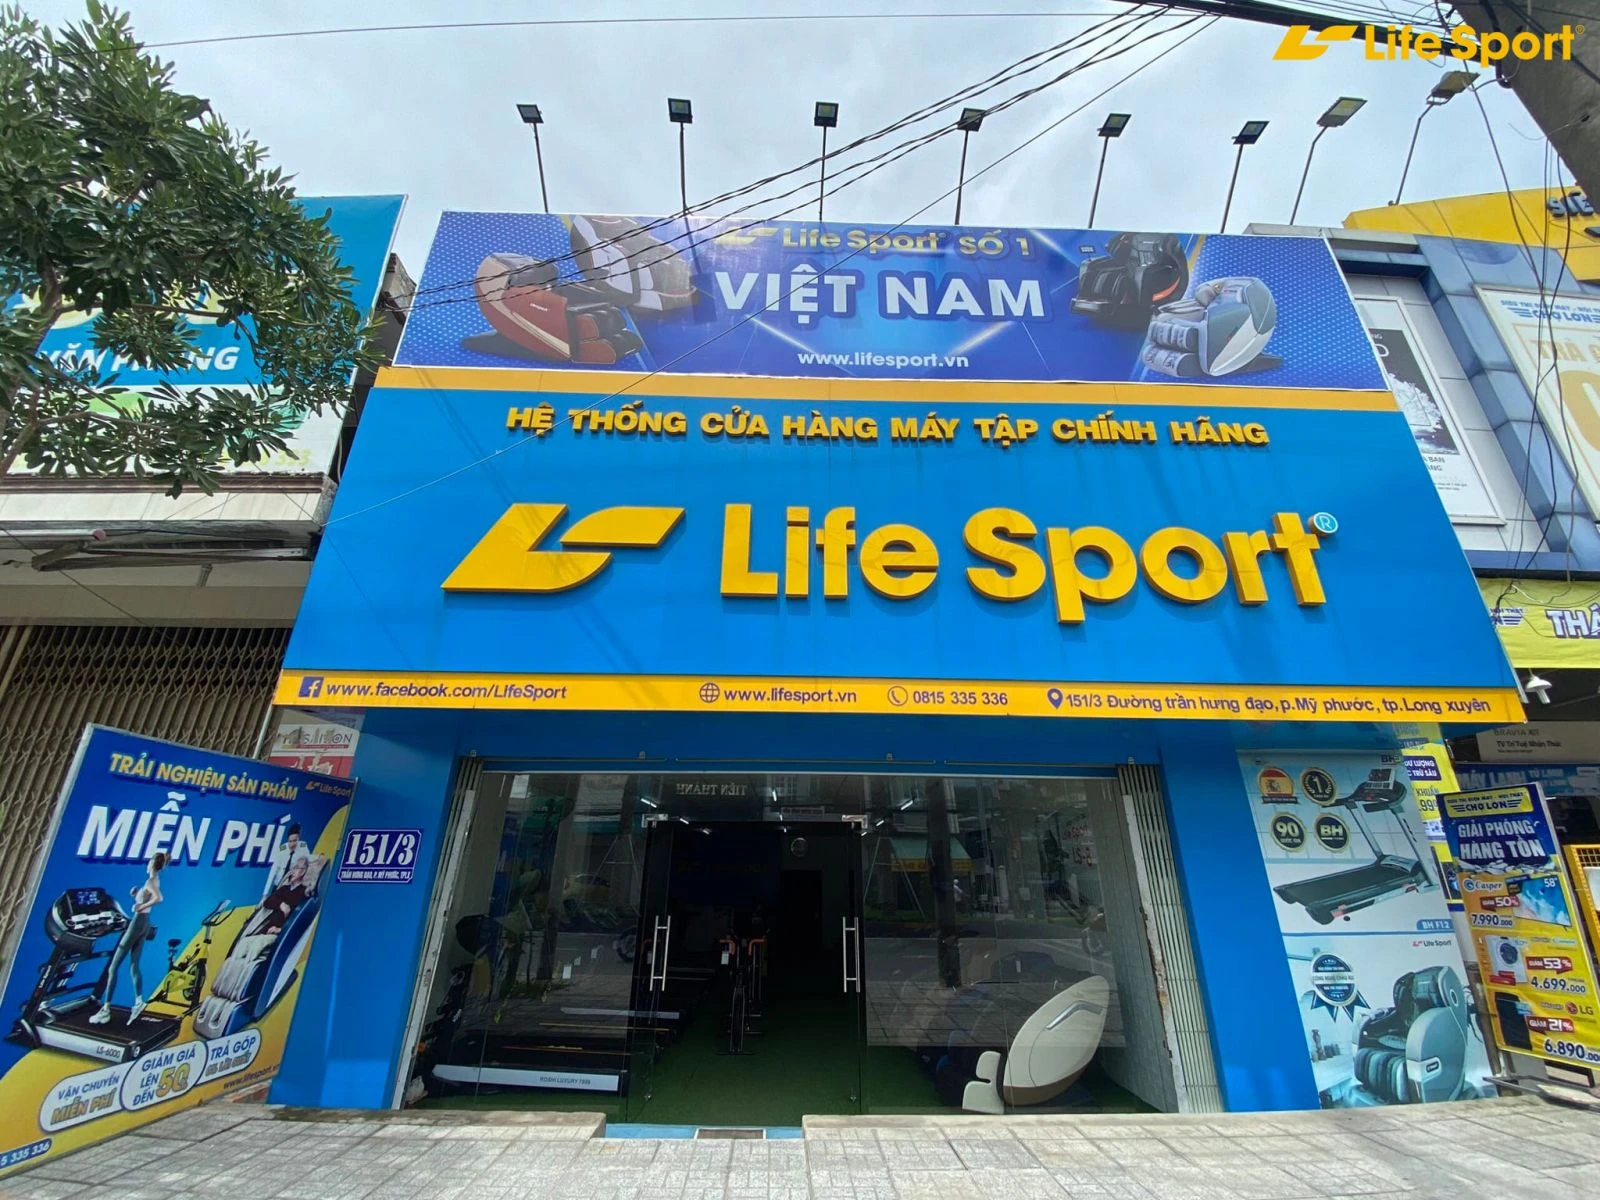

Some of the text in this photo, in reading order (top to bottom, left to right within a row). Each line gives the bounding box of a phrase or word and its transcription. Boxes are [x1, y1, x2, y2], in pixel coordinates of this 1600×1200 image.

[783, 227, 841, 249] Life
[847, 231, 940, 255] Sport
[1015, 236, 1030, 256] 1
[715, 263, 1045, 324] VIỆT NAM
[797, 351, 969, 369] www.lifesport.vn
[506, 401, 1270, 449] HỆ THỐNG CỬA HÀNG MÁY TẬP CHÍNH HÃNG
[720, 503, 939, 601] Life
[963, 506, 1327, 624] Sport
[326, 681, 567, 700] www.facebook.com/LifeSport
[724, 687, 857, 704] www.lifesport.vn
[913, 691, 1008, 706] 0815 335 336
[1066, 693, 1102, 708] 151/3
[1107, 695, 1163, 712] Đường
[1165, 692, 1196, 710] trần
[1200, 696, 1241, 713] hưng
[1447, 698, 1491, 714] xuyên
[109, 752, 299, 801] TRẢI NGHIỆM SẢN PHẨM
[76, 791, 292, 864] MIỄN PHÍ
[1276, 821, 1299, 838] 90
[1320, 824, 1343, 837] BH
[1458, 818, 1536, 838] GIẢI PHÓNG
[345, 832, 416, 866] 151/3
[1460, 838, 1505, 860] HÀNG
[1474, 879, 1503, 891] Casper
[1531, 976, 1586, 993] 4.699.000
[1579, 1005, 1594, 1015] LG
[142, 1045, 196, 1072] GIẢM GIÁ
[210, 1041, 230, 1061] TRẢ
[58, 1072, 120, 1101] VẬN CHUYỂN
[140, 1072, 159, 1088] LÊN
[133, 1087, 154, 1106] ĐẾN
[10, 1148, 30, 1163] 335
[31, 1141, 50, 1155] 336
